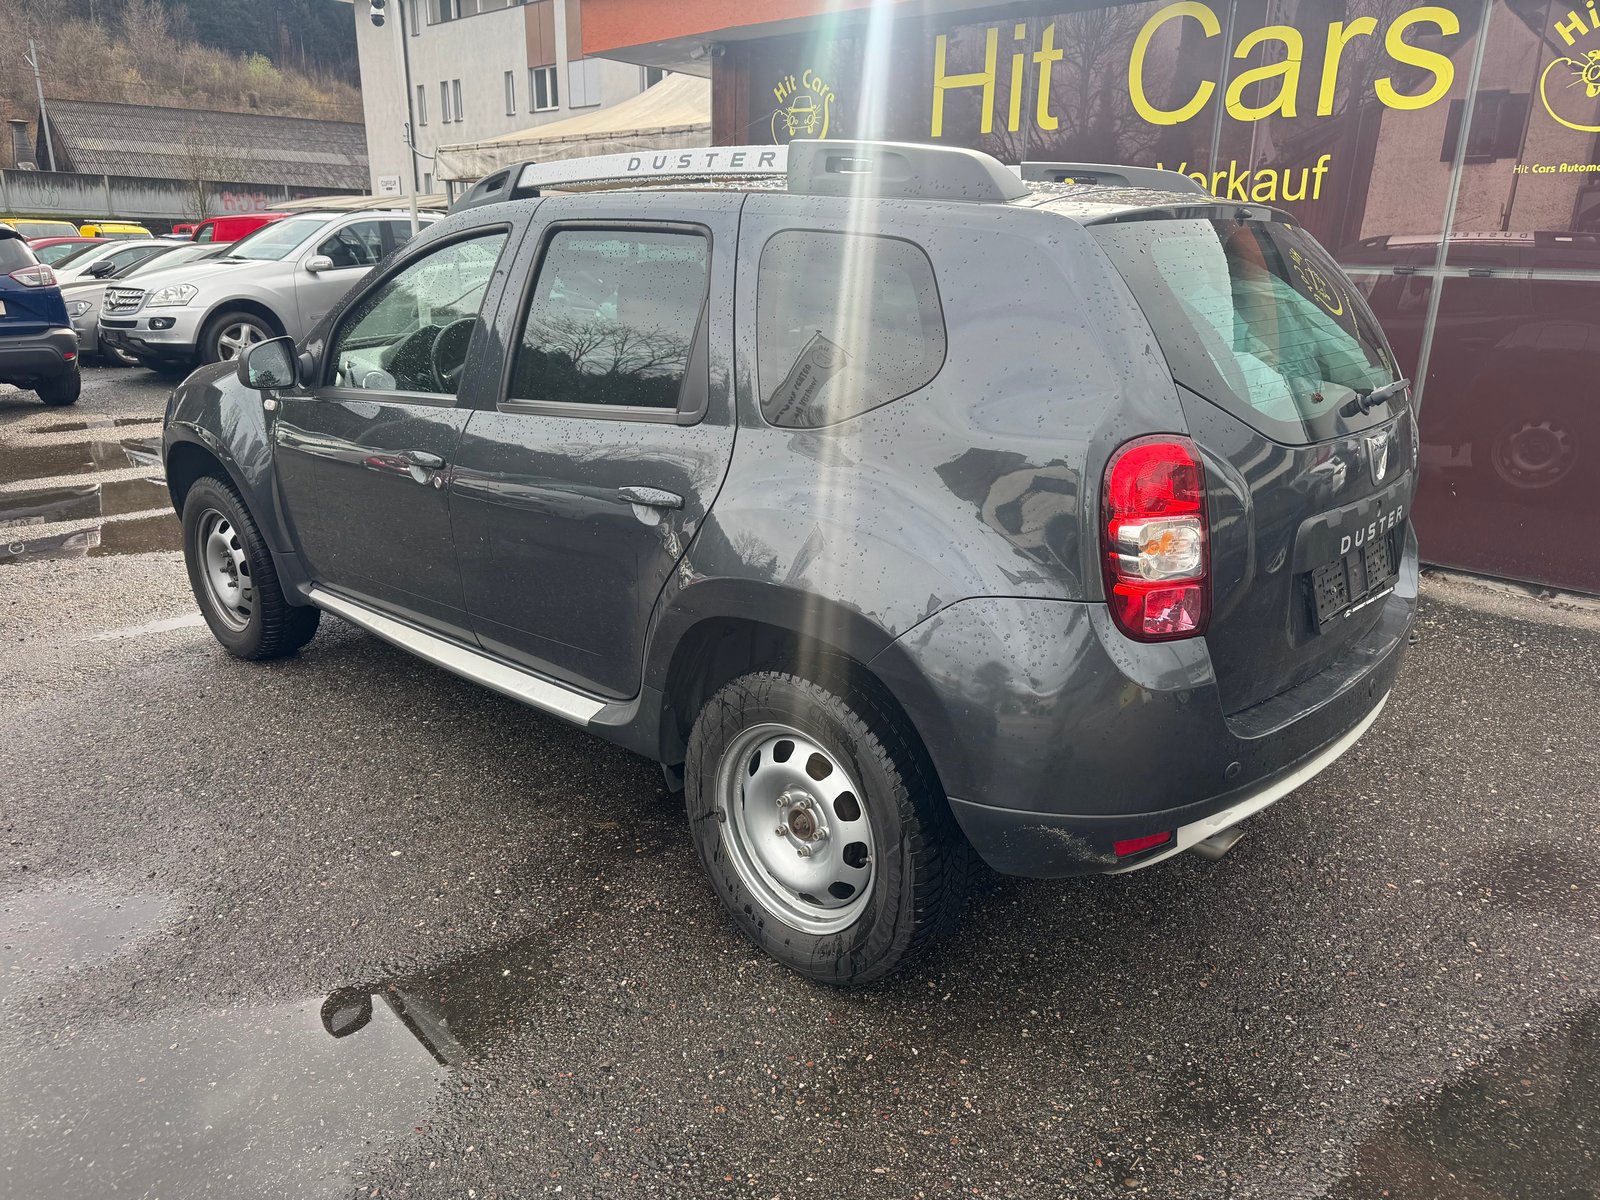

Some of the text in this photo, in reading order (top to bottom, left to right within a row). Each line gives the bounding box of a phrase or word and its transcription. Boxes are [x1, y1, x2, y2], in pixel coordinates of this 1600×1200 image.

[1554, 0, 1600, 46] Hi
[773, 68, 834, 103] Hit Cars
[930, 1, 1460, 138] Hit Cars
[627, 151, 776, 172] DUSTER
[1157, 154, 1331, 202] rkauf
[1512, 164, 1529, 174] Hit
[1532, 164, 1556, 173] Cars
[1341, 505, 1403, 555] DUSTER
